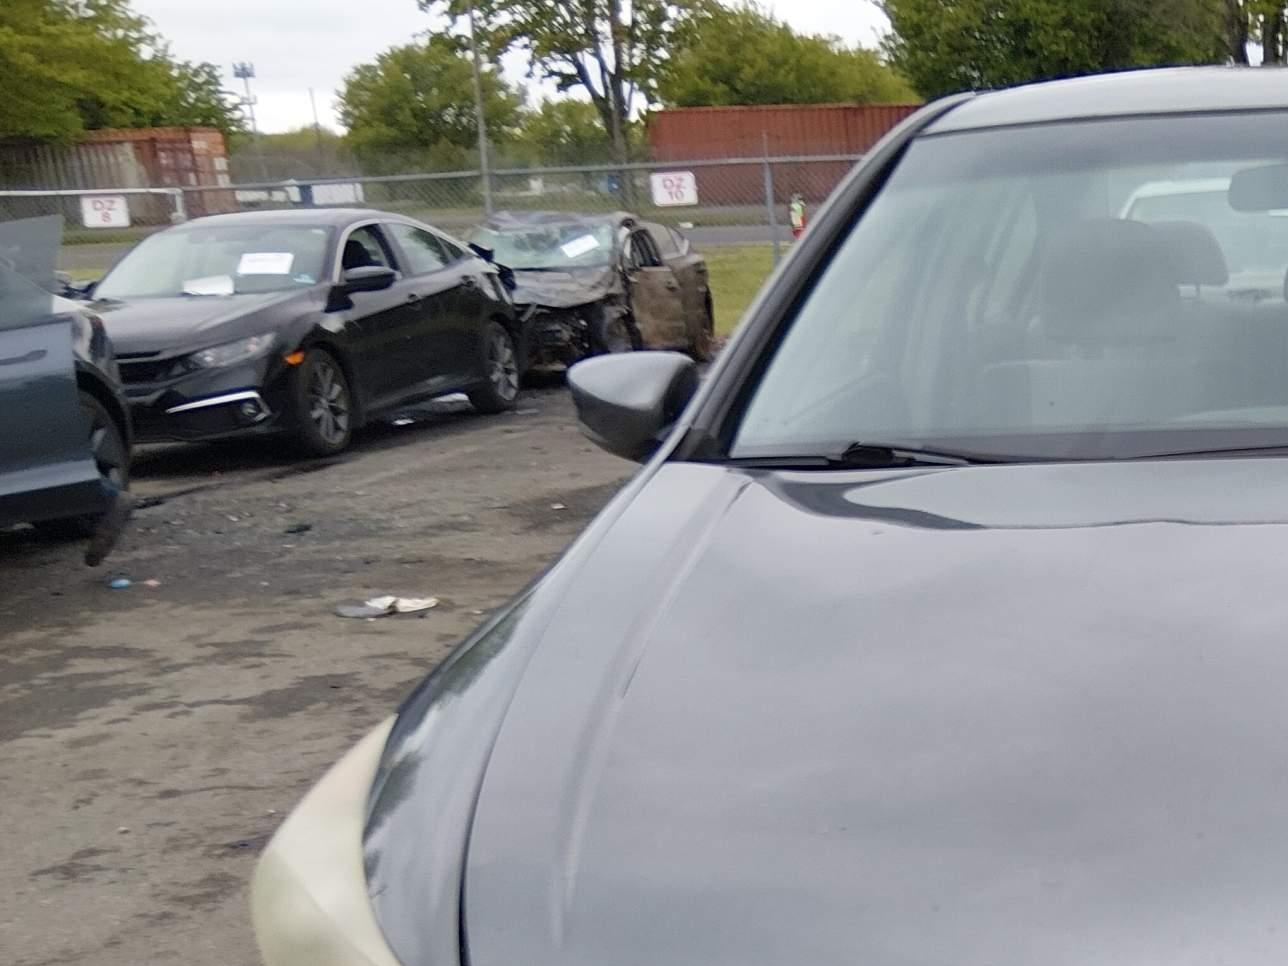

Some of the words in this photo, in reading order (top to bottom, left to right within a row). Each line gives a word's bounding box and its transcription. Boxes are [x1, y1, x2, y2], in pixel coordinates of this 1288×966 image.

[662, 176, 687, 190] DZ
[667, 190, 685, 201] 10
[92, 199, 117, 211] DZ
